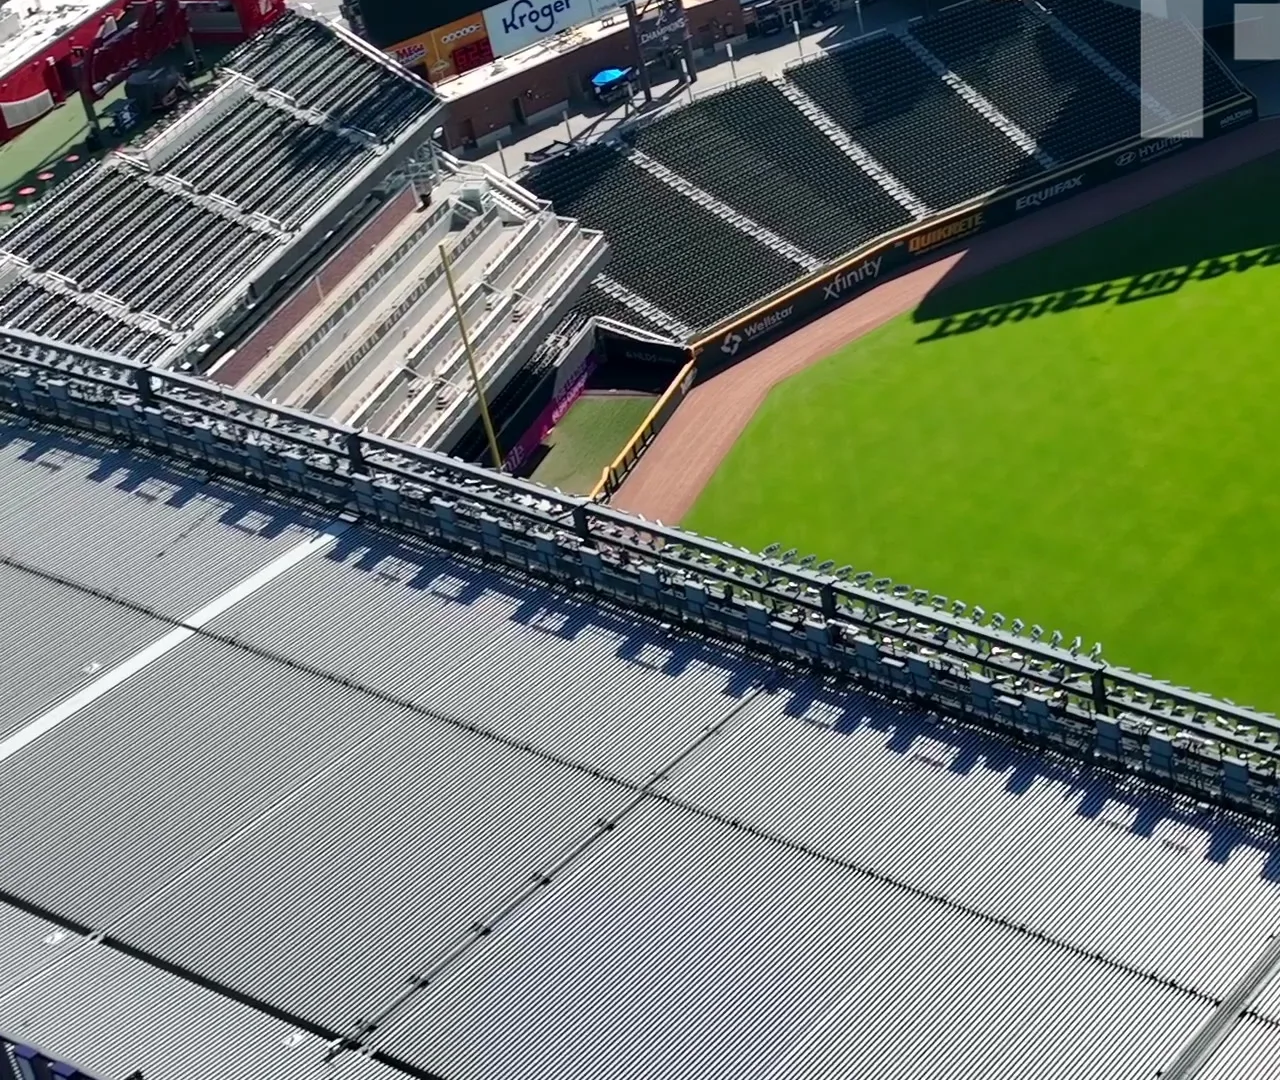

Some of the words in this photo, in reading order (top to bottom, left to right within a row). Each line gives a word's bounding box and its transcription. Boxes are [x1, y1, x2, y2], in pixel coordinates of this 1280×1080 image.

[641, 16, 686, 44] CHAMPIONS
[1139, 126, 1194, 159] HYUNDAI
[1015, 172, 1087, 212] EQUIFAX
[908, 214, 983, 253] QUIKRETE
[823, 256, 883, 302] xfinity
[744, 303, 795, 339] Wellstar
